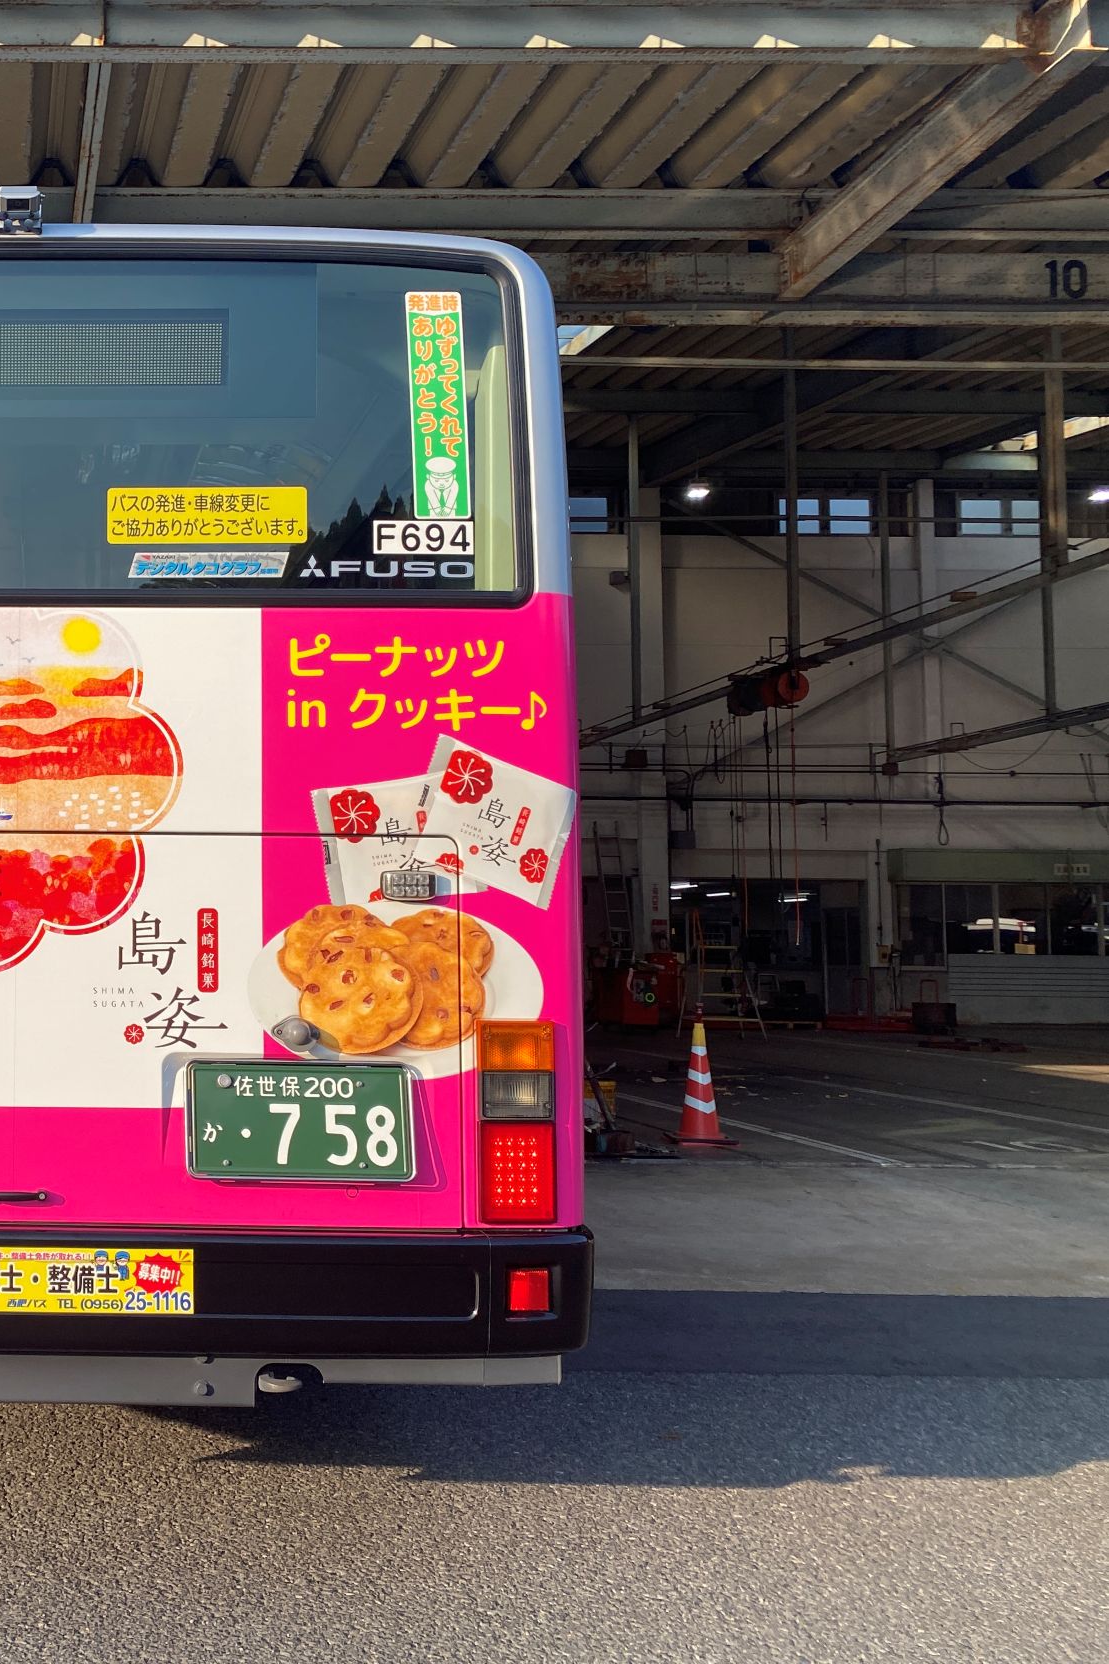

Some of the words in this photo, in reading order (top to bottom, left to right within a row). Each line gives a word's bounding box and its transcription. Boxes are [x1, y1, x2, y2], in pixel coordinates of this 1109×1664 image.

[1044, 259, 1088, 299] 10
[407, 294, 458, 312] 発進時
[435, 316, 462, 457] ゆずってくれて
[110, 493, 270, 513] バスの発進・車線変更に
[110, 515, 304, 537] ご協力ありがとうございます。
[376, 523, 471, 552] F694
[330, 560, 474, 578] FUSO
[289, 633, 505, 678] ピーナッツ
[287, 688, 327, 728] in
[201, 912, 215, 989] 長崎銘菓
[93, 986, 135, 995] SHIMA
[93, 1000, 144, 1008] SUGATA
[233, 1074, 355, 1099] 佐世保200
[202, 1121, 223, 1143] か
[6, 1298, 47, 1309] 西肥バス
[57, 1298, 77, 1309] TEL
